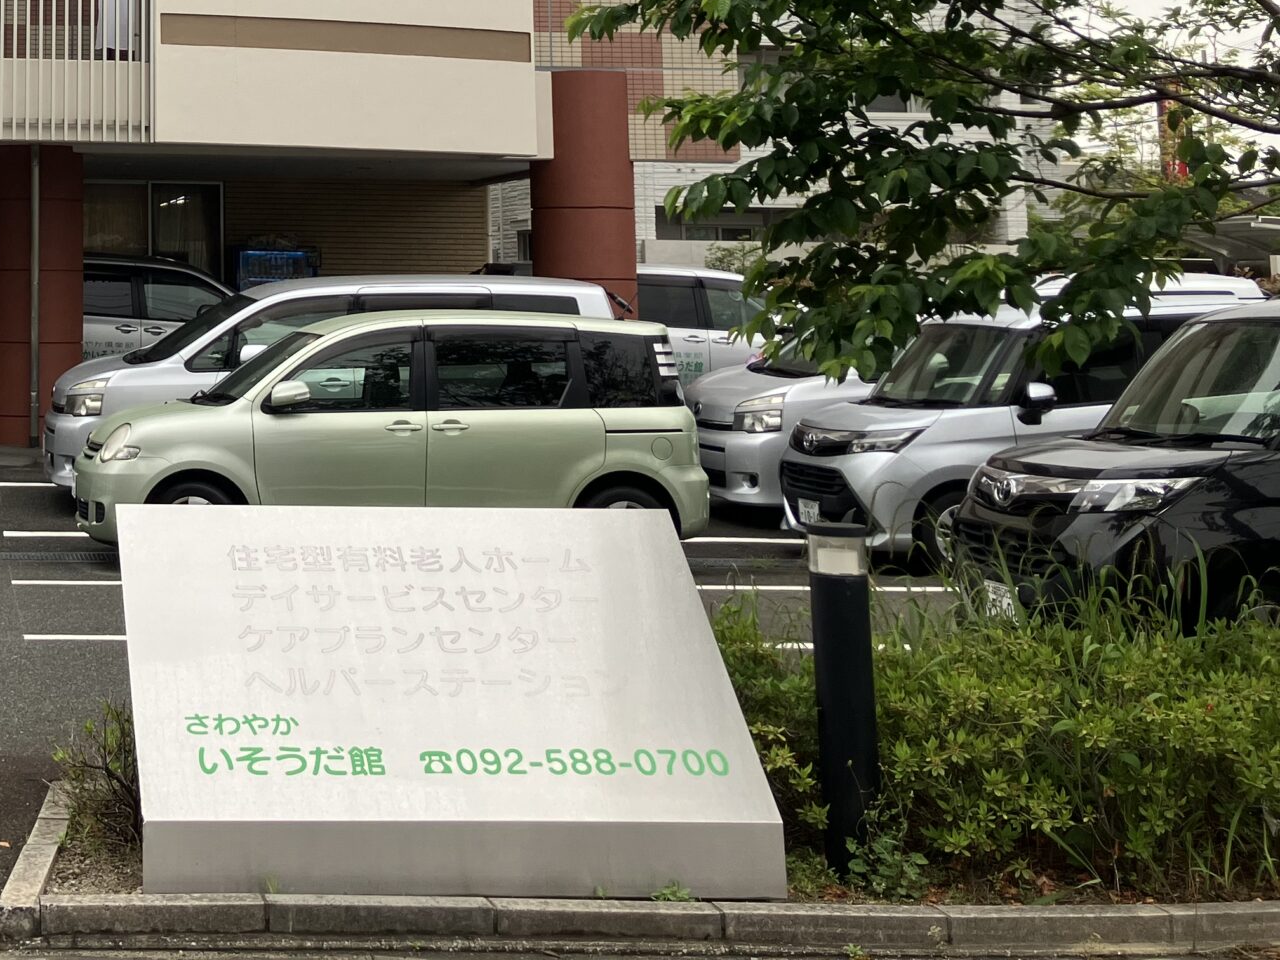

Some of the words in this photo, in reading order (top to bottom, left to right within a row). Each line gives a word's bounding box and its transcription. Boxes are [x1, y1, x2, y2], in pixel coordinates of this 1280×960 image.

[226, 543, 593, 575] 住宅型有料老人ホーム
[231, 583, 599, 614] デイサービスセンター
[238, 624, 577, 655] ケアプランセンター
[244, 666, 630, 699] ヘルパーステーション
[183, 712, 300, 737] さわやか
[197, 745, 387, 778] いそうだ館
[455, 747, 731, 778] 092-588-0700
